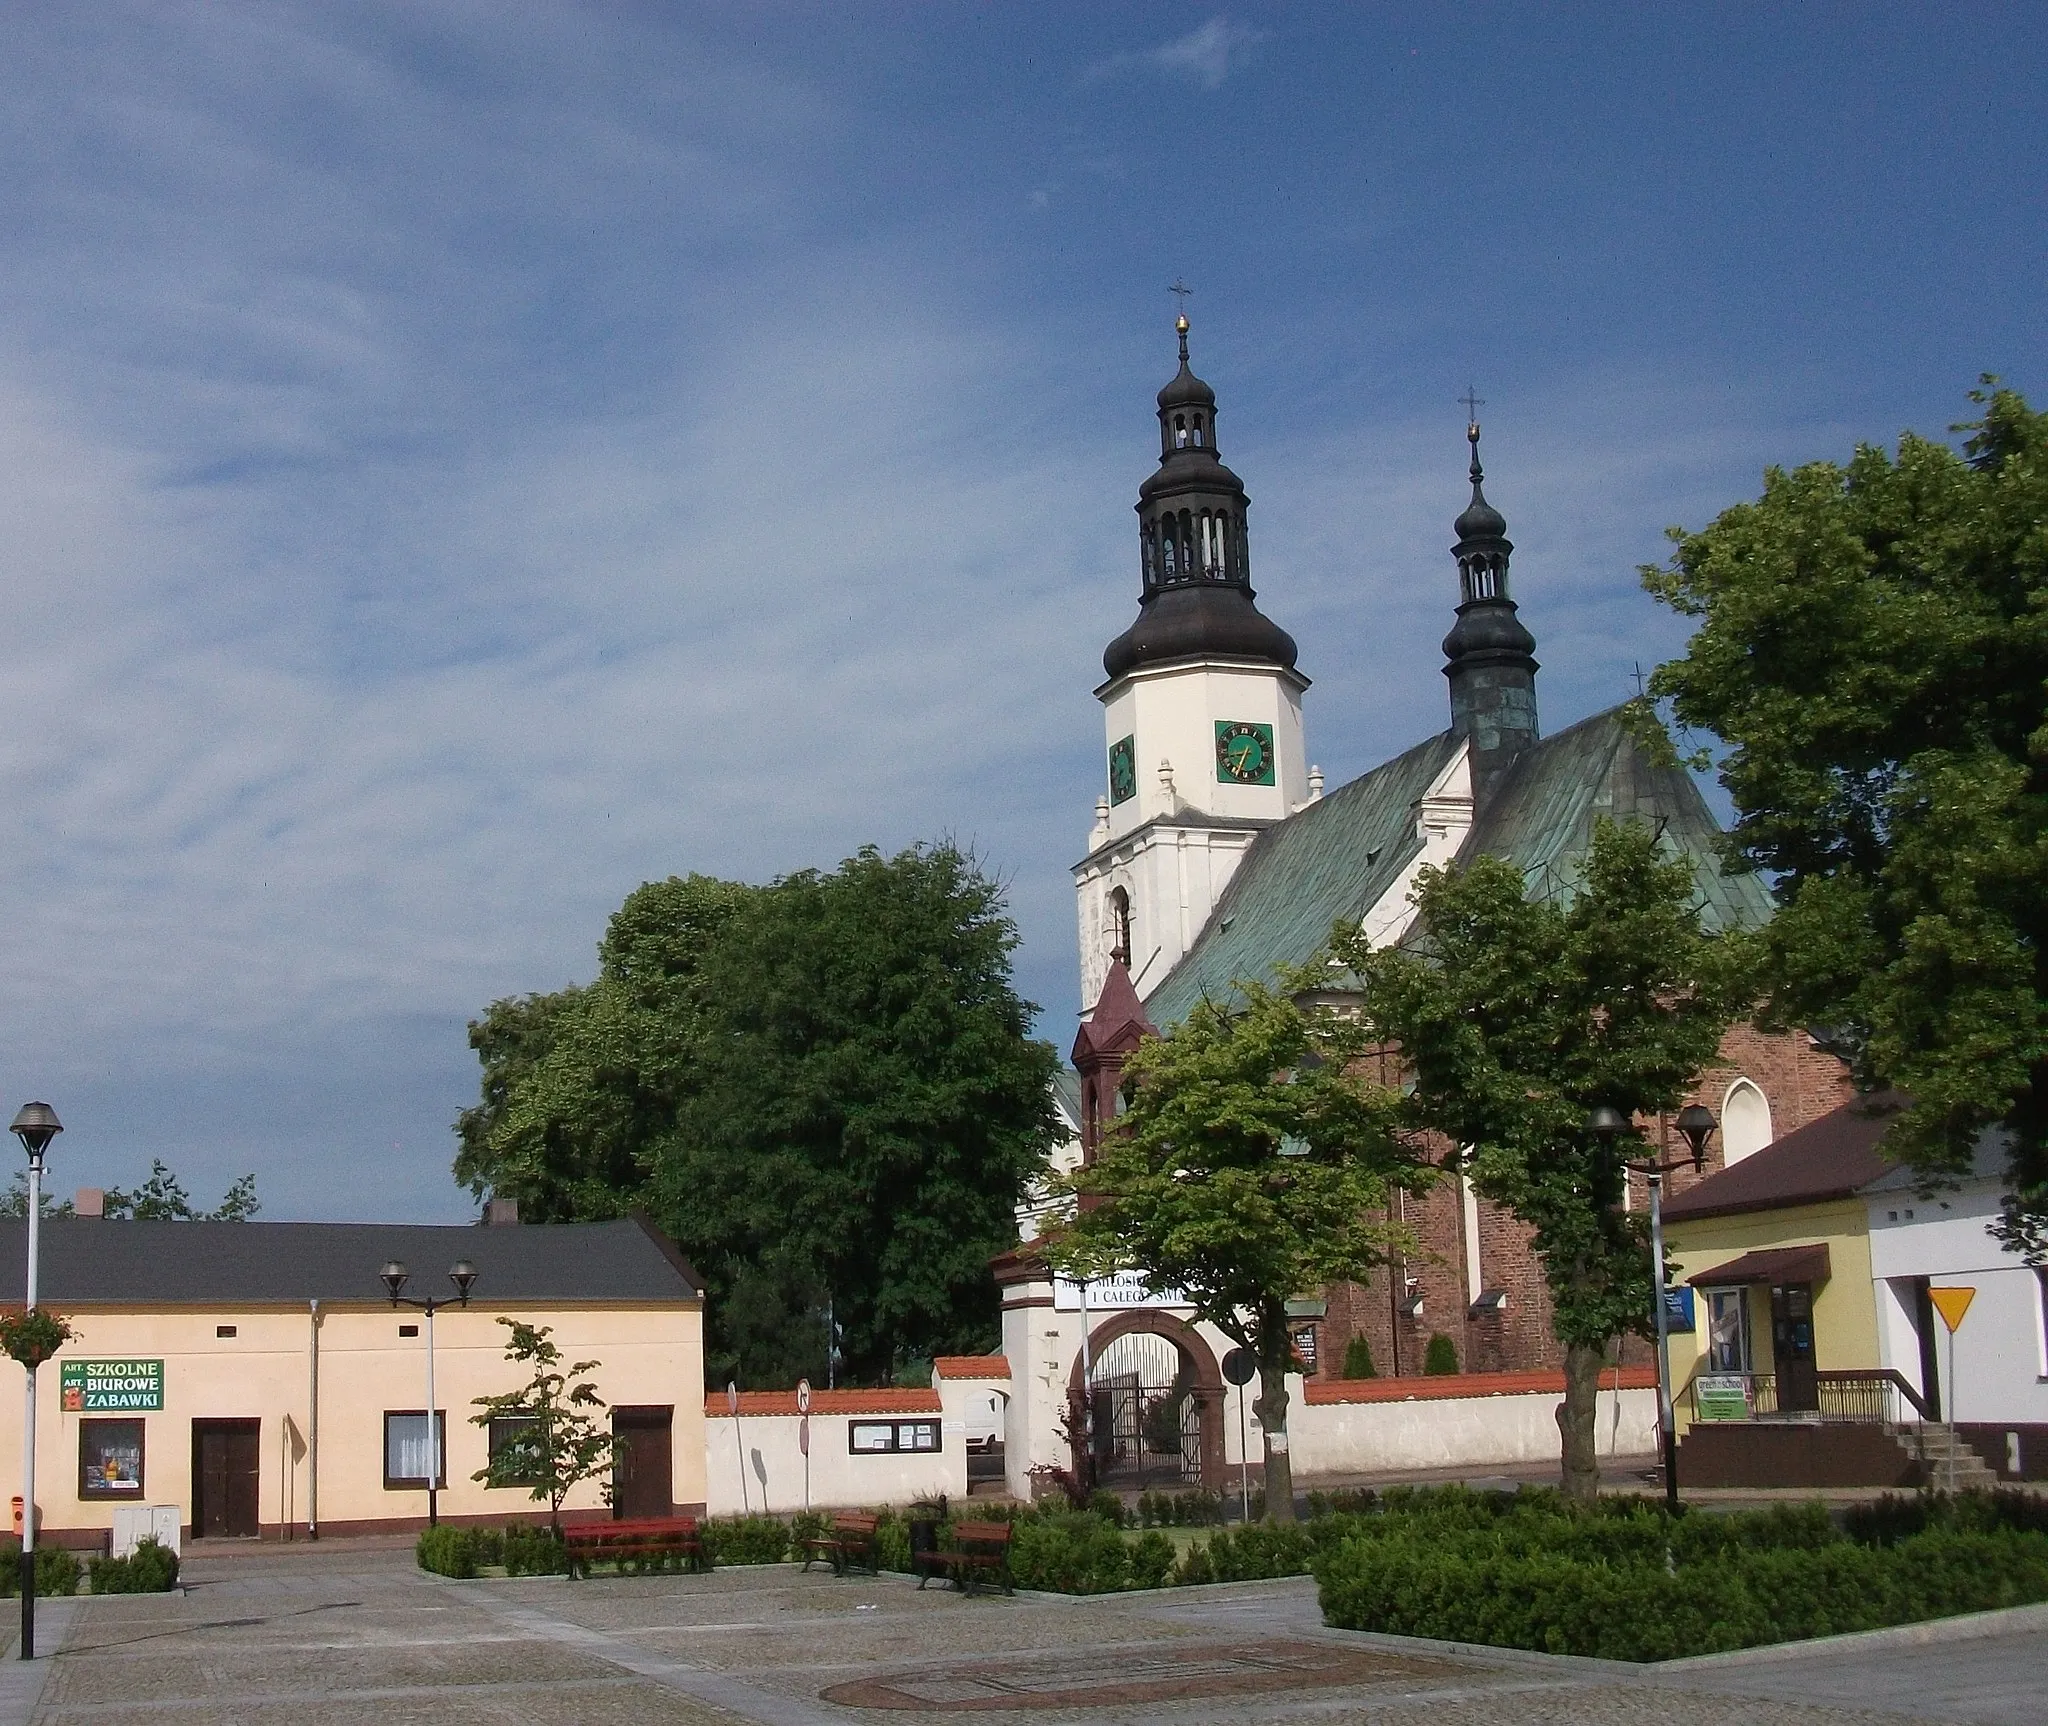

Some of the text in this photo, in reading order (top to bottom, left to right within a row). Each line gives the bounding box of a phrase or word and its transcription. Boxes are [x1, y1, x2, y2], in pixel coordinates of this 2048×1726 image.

[64, 1363, 158, 1376] ART. SZKOLNE
[64, 1378, 159, 1391] ART. BIUROWE
[86, 1394, 158, 1407] ZABAWKI
